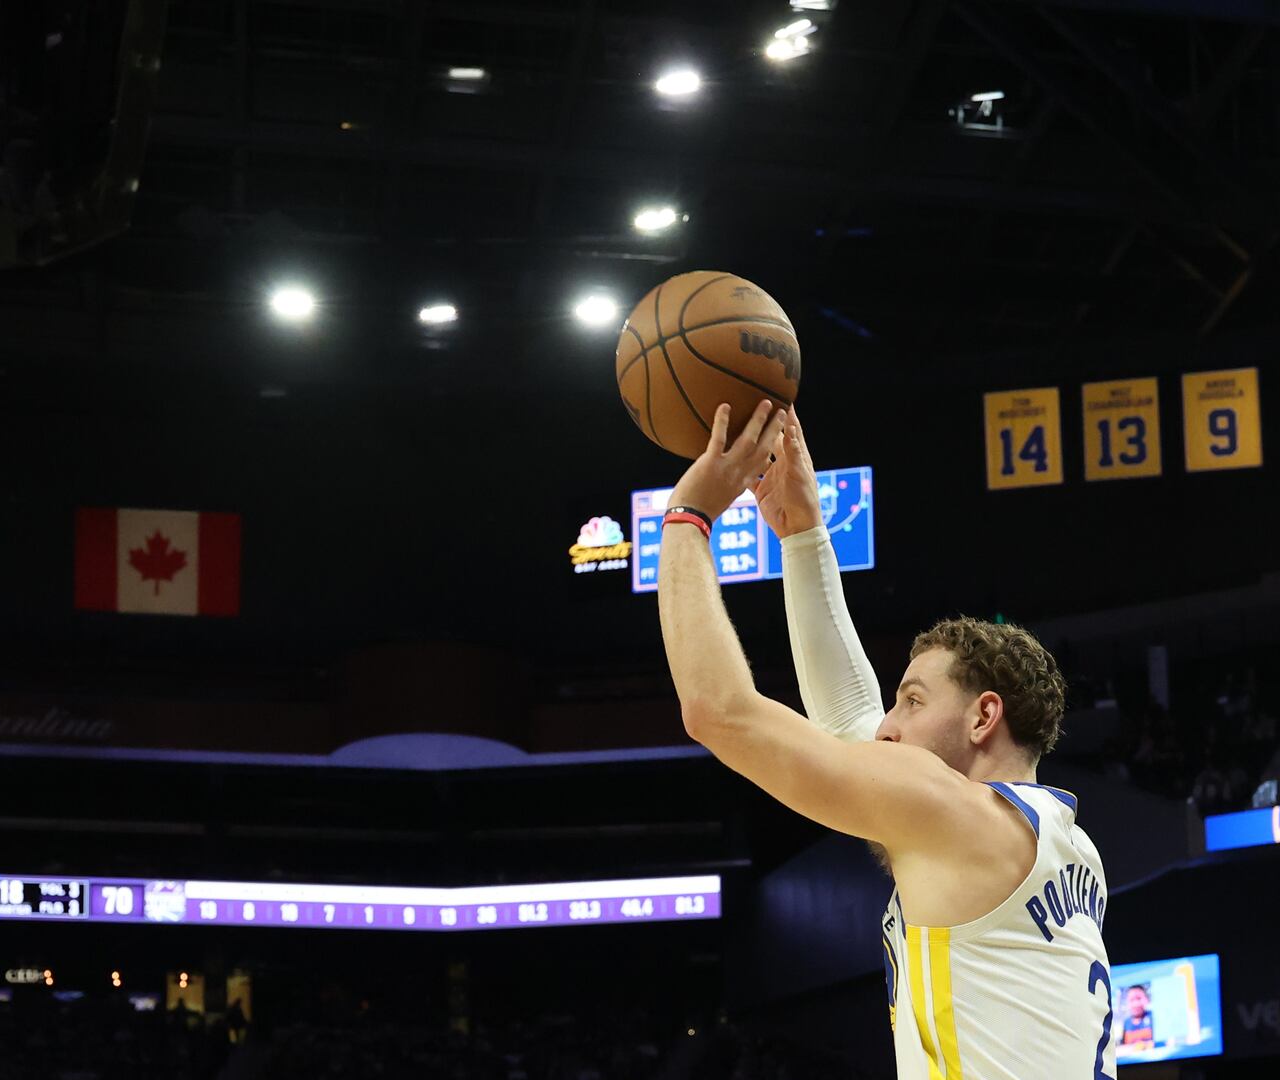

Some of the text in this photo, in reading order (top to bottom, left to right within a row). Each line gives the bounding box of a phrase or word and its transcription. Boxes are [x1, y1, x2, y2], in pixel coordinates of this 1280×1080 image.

[1000, 425, 1047, 476] 14
[1097, 416, 1147, 467] 13
[1208, 408, 1238, 457] 9
[101, 886, 134, 915] 70
